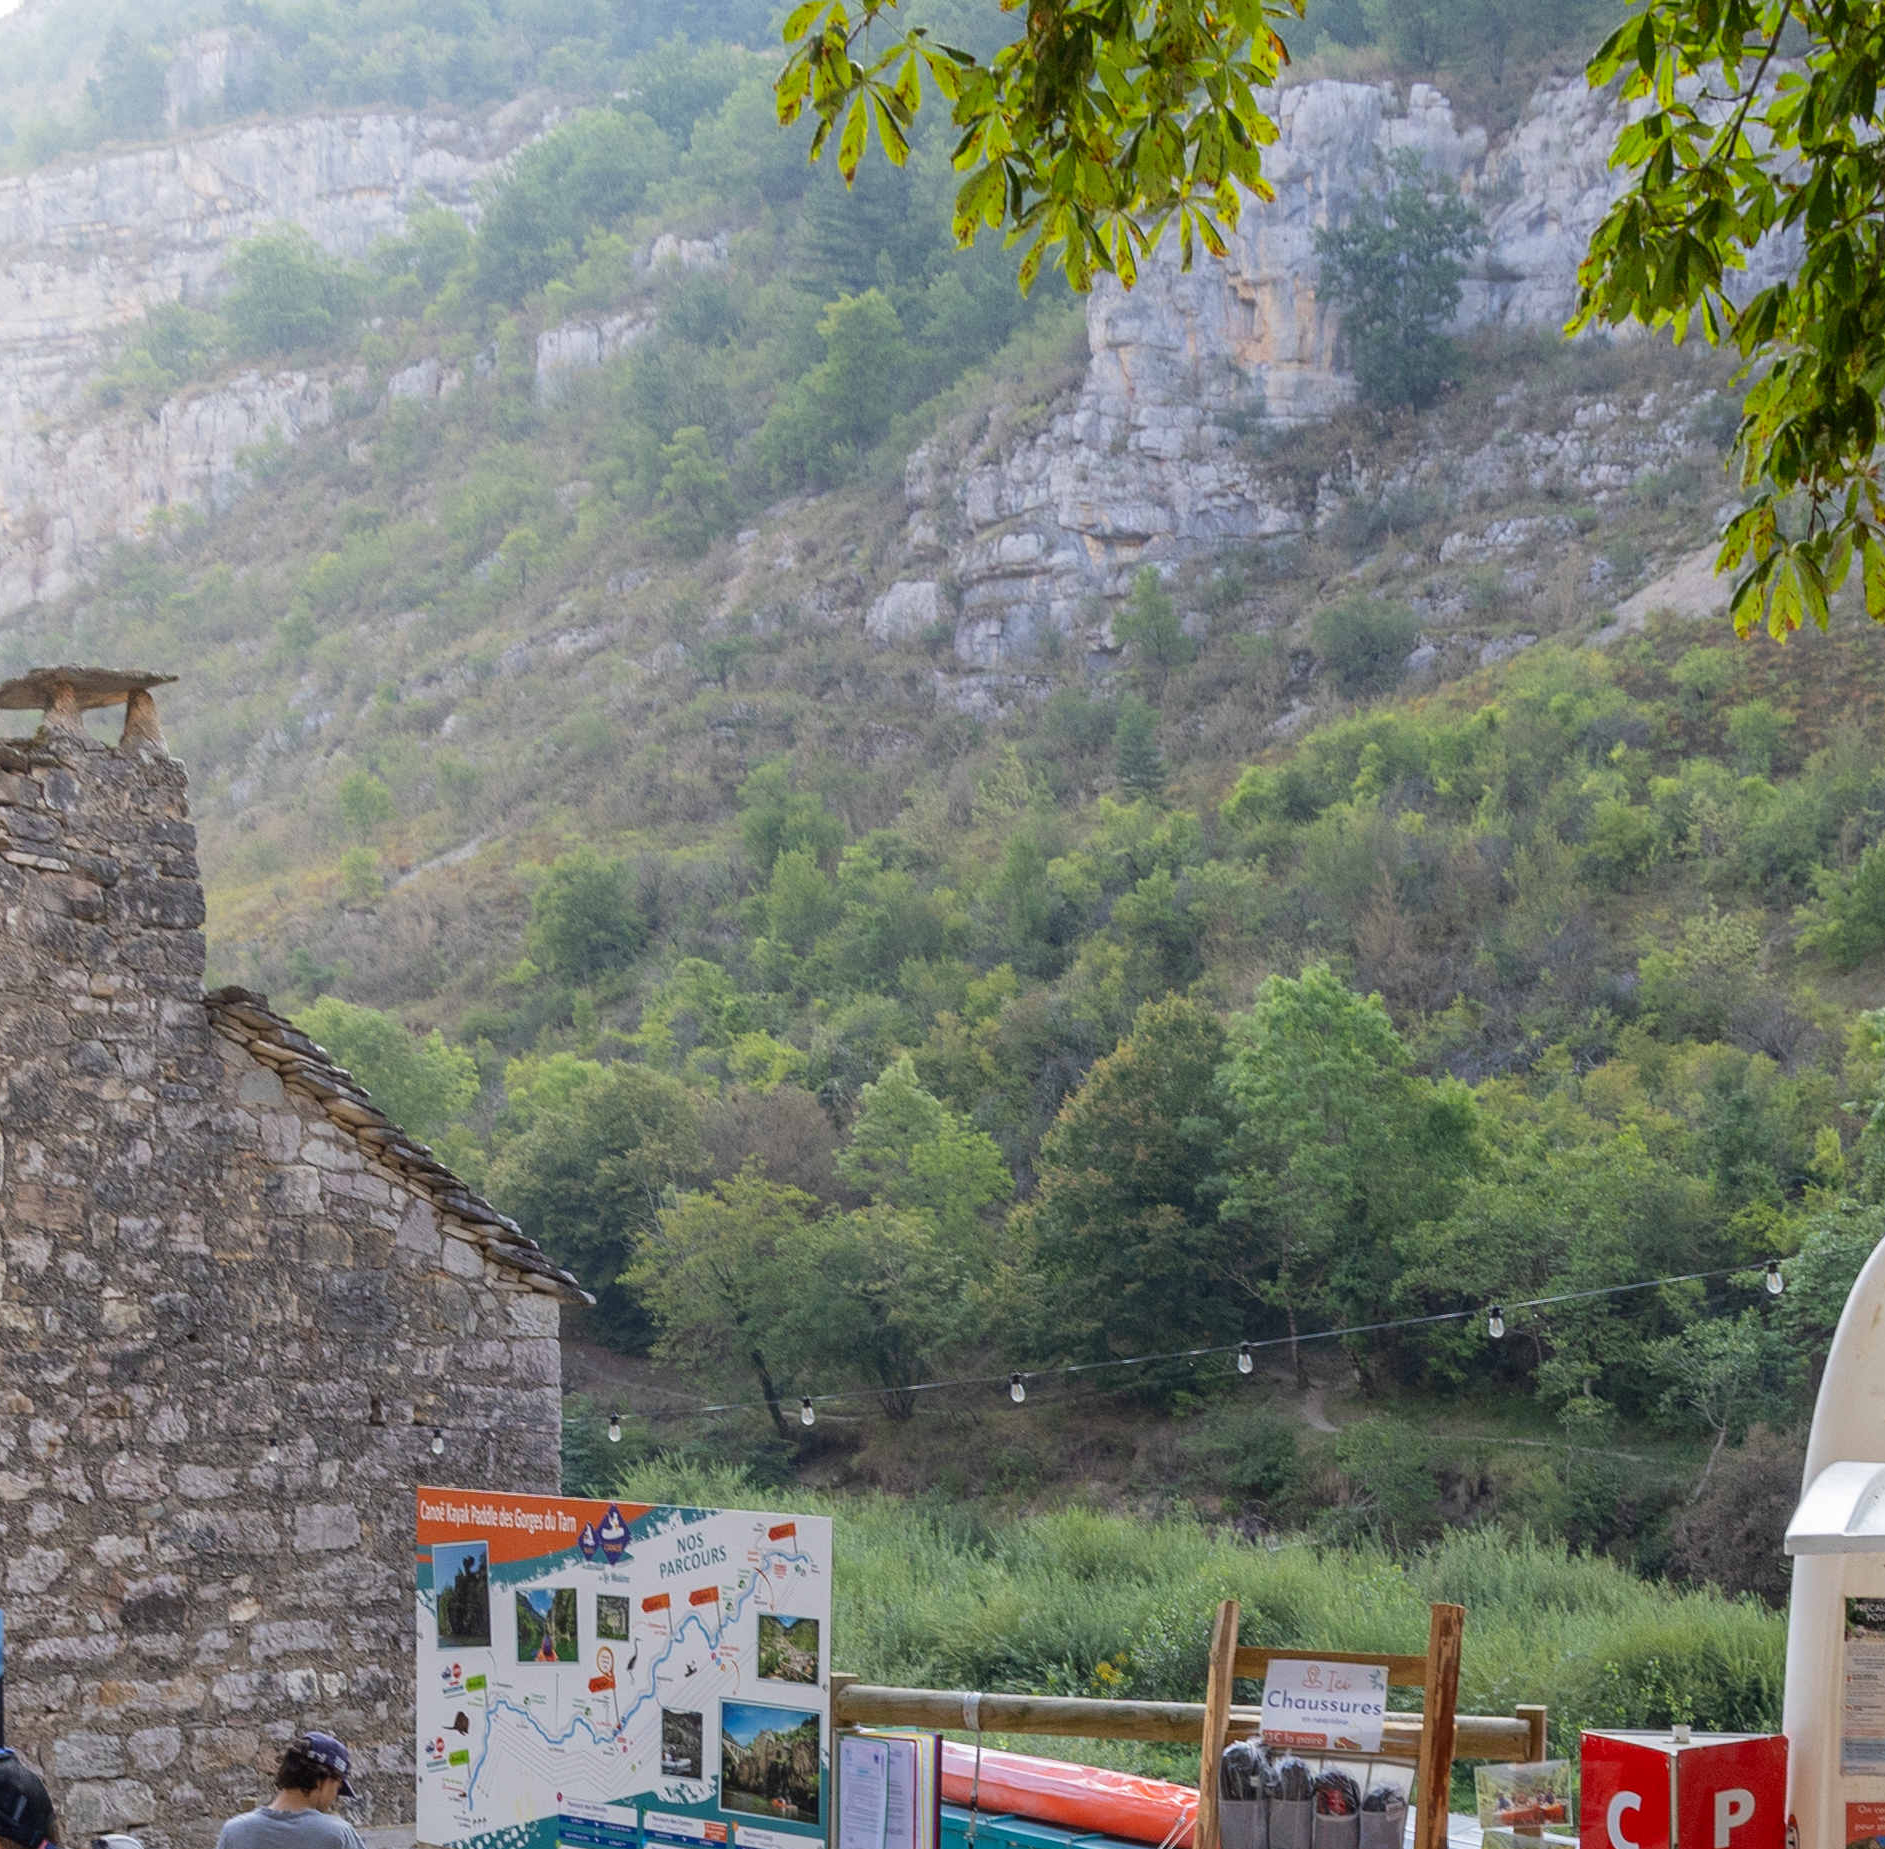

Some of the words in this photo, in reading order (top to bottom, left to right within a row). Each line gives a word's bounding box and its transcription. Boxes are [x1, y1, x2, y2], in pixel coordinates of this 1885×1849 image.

[420, 1500, 445, 1522] Canoë
[446, 1501, 470, 1527] Kayak
[471, 1504, 498, 1527] Paddle
[499, 1506, 514, 1528] des
[515, 1508, 544, 1535] Gorges
[544, 1508, 557, 1532] du
[557, 1511, 577, 1533] Tarn
[676, 1531, 705, 1554] NOS
[659, 1545, 727, 1579] PARCOURS
[1325, 1669, 1353, 1693] Ici
[1267, 1689, 1382, 1716] Chaussures
[1297, 1735, 1324, 1747] paire
